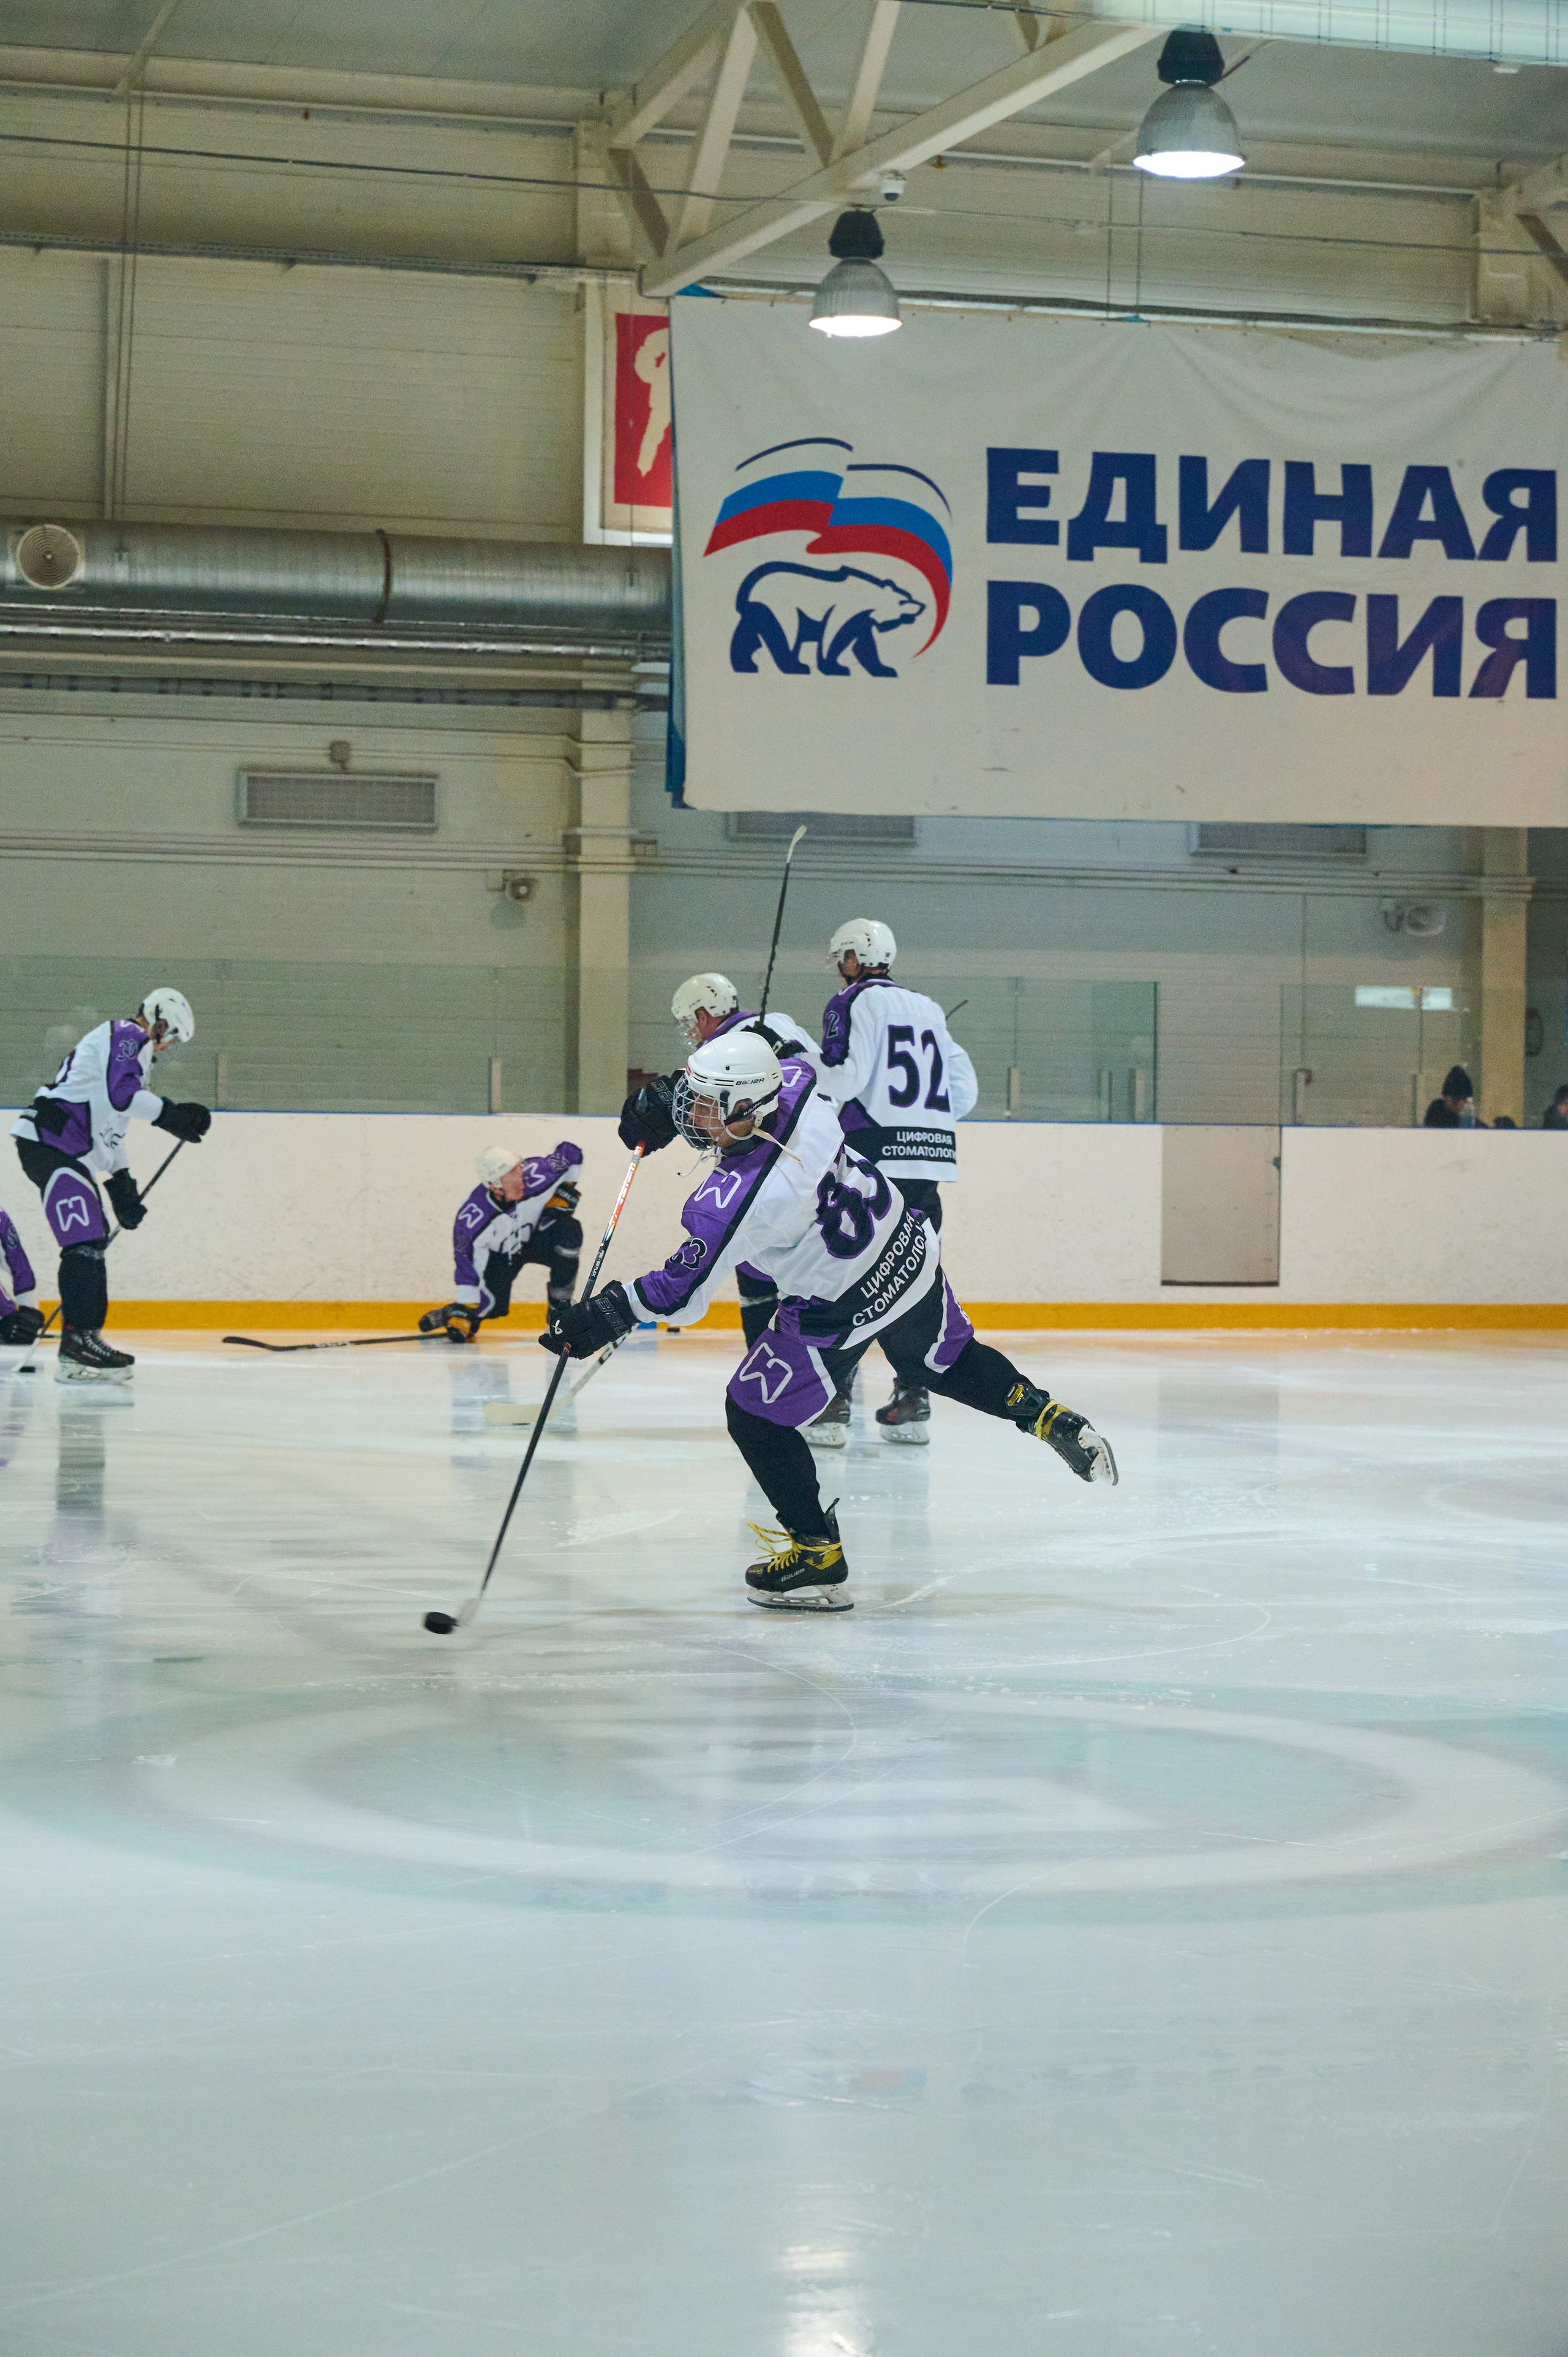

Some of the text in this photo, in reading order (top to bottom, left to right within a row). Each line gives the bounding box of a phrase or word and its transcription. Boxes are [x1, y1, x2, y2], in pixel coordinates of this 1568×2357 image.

[986, 447, 1558, 564] ЕДИНАЯ
[986, 580, 1558, 700] РОССИЯ
[888, 1024, 951, 1113] 52
[896, 1131, 952, 1145] ЦИФРОВАЯ
[861, 1211, 914, 1299] ЦИФРОВАЯ
[781, 1567, 805, 1582] BAUER
